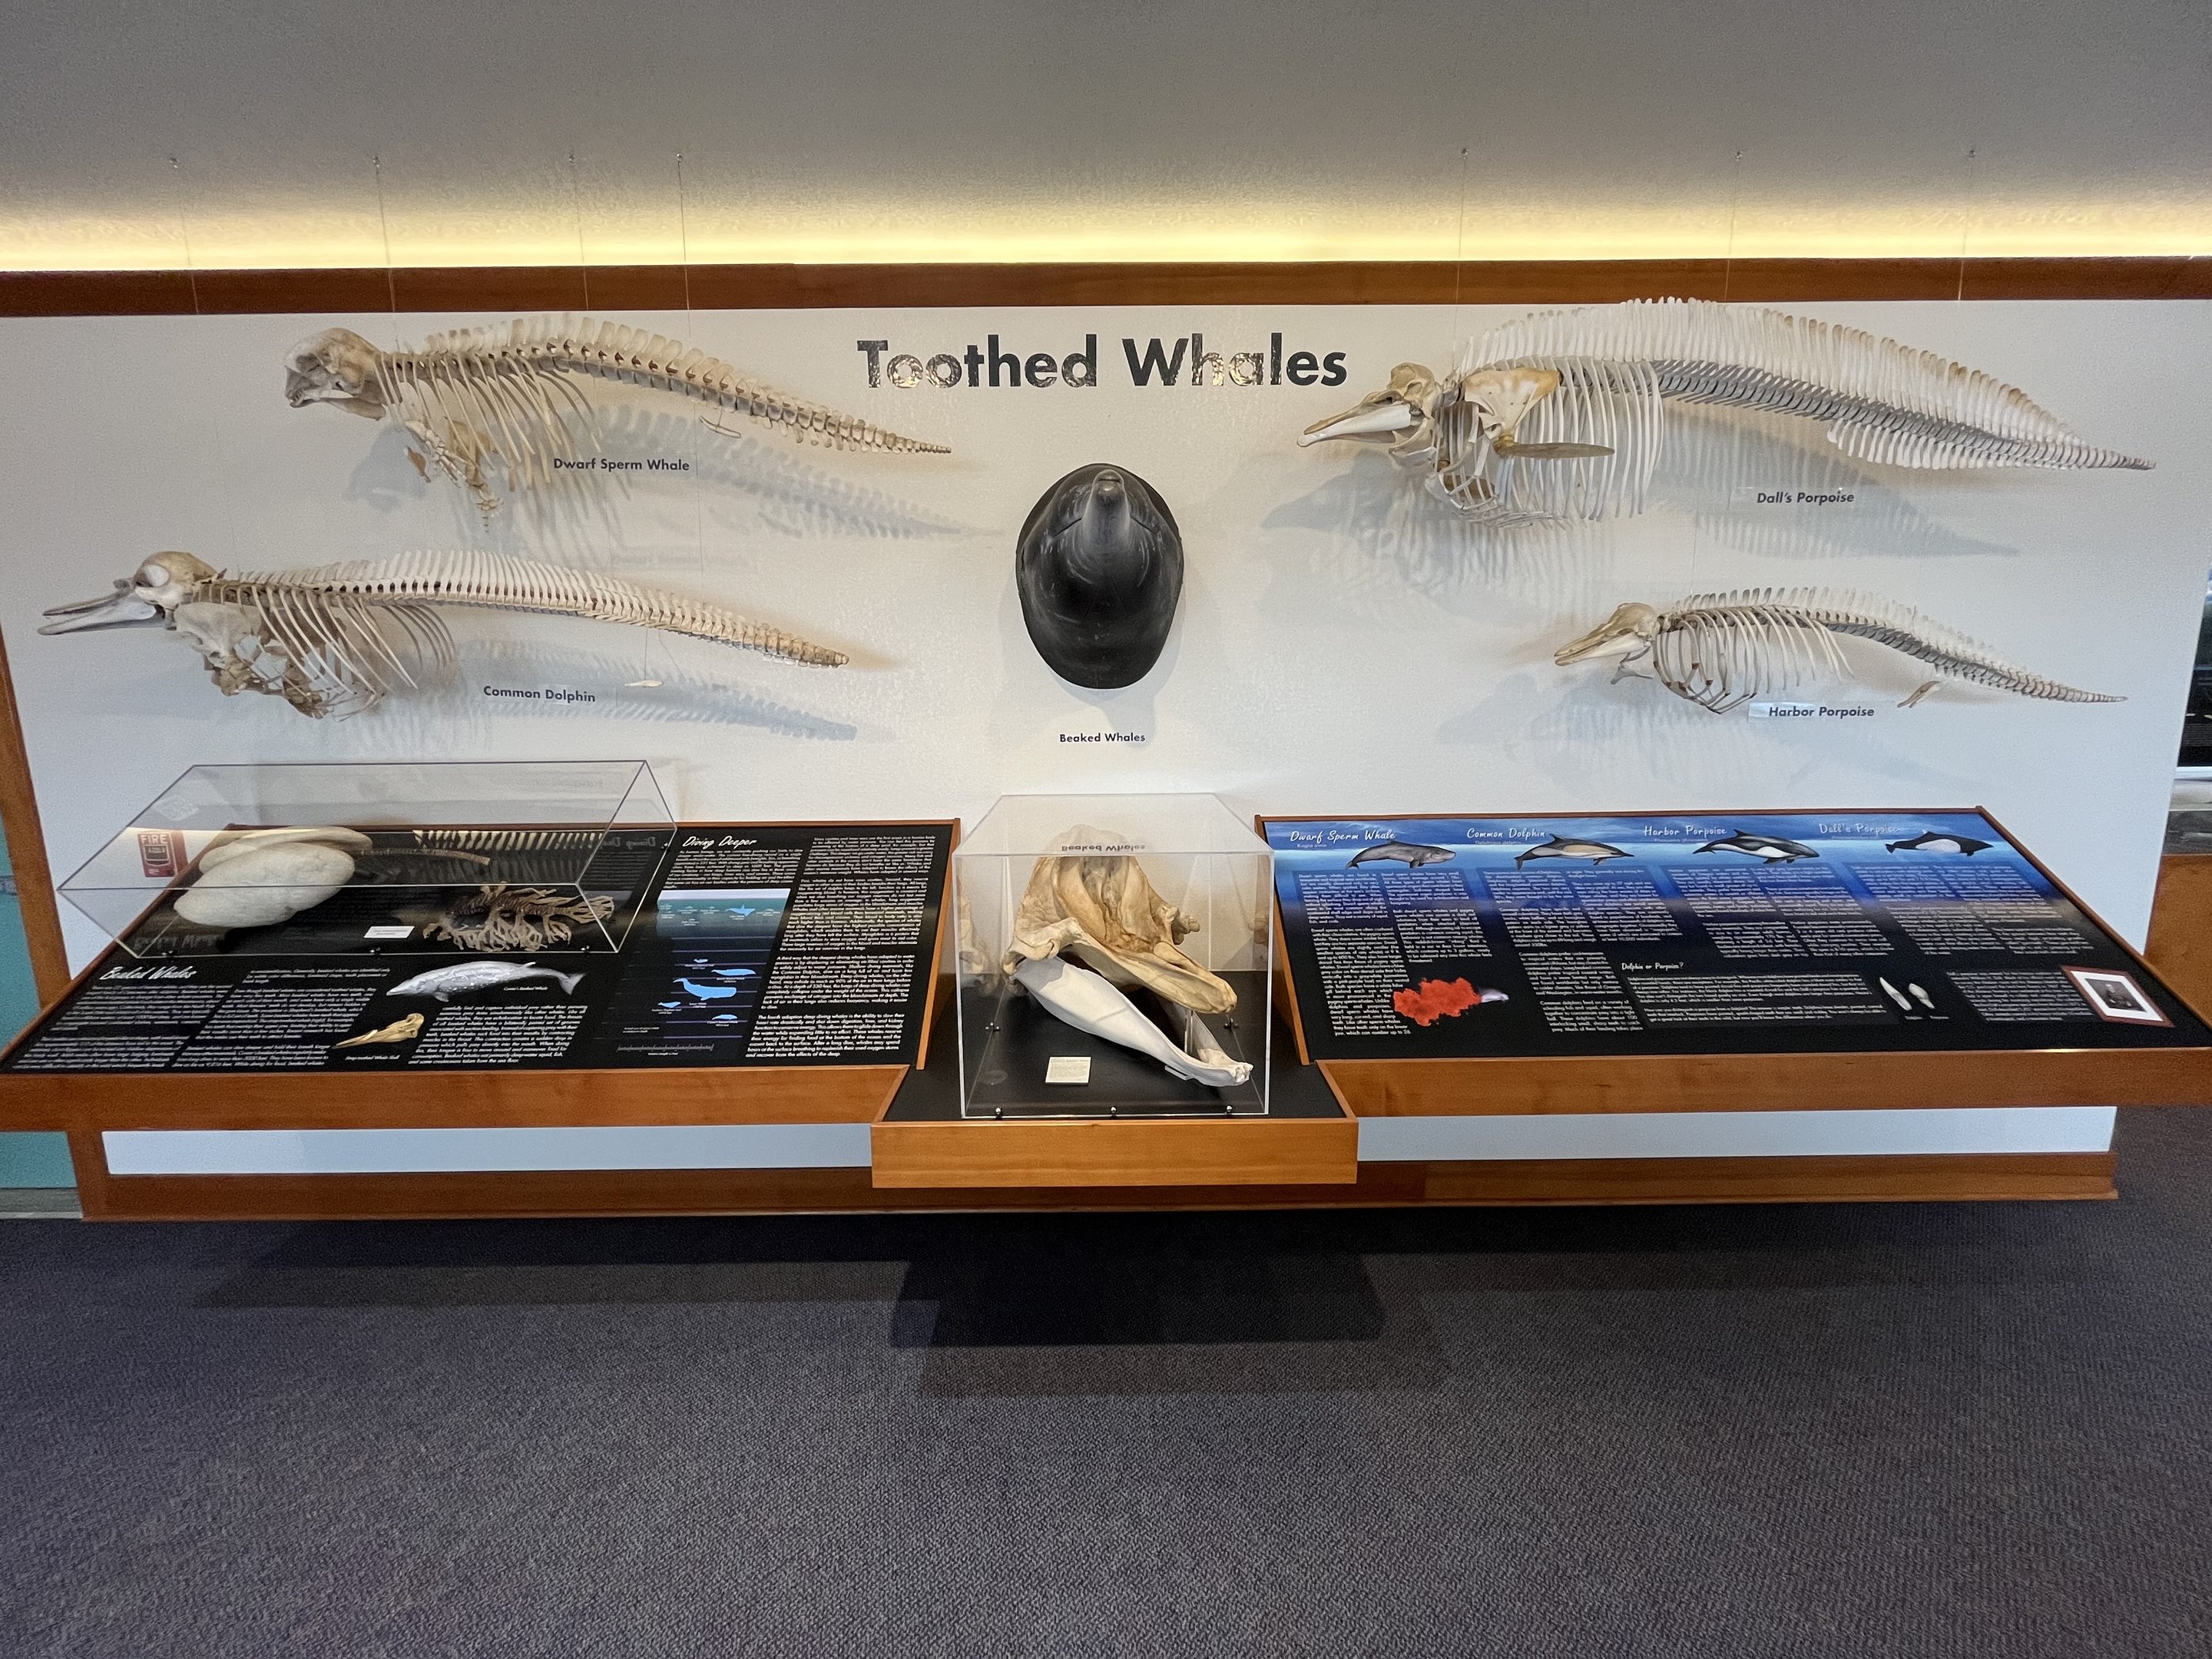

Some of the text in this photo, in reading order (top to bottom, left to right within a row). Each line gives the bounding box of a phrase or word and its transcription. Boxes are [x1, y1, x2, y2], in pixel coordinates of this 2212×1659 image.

[857, 333, 1348, 388] Toothed Whales
[554, 459, 690, 472] Dwarf Sperm Whale
[1757, 492, 1854, 505] Dall's Porpoise
[483, 686, 595, 703] Common Dolphin
[1769, 706, 1875, 718] Harbor Porpoise
[1059, 732, 1145, 743] Beaked Whales
[1290, 830, 1396, 843] Dwarf Sperm Whale
[1466, 827, 1545, 841] Common Dolphin
[1644, 825, 1727, 838] Harbor Porpoise
[140, 834, 168, 844] FIRE
[682, 835, 757, 849] Diving Deeper
